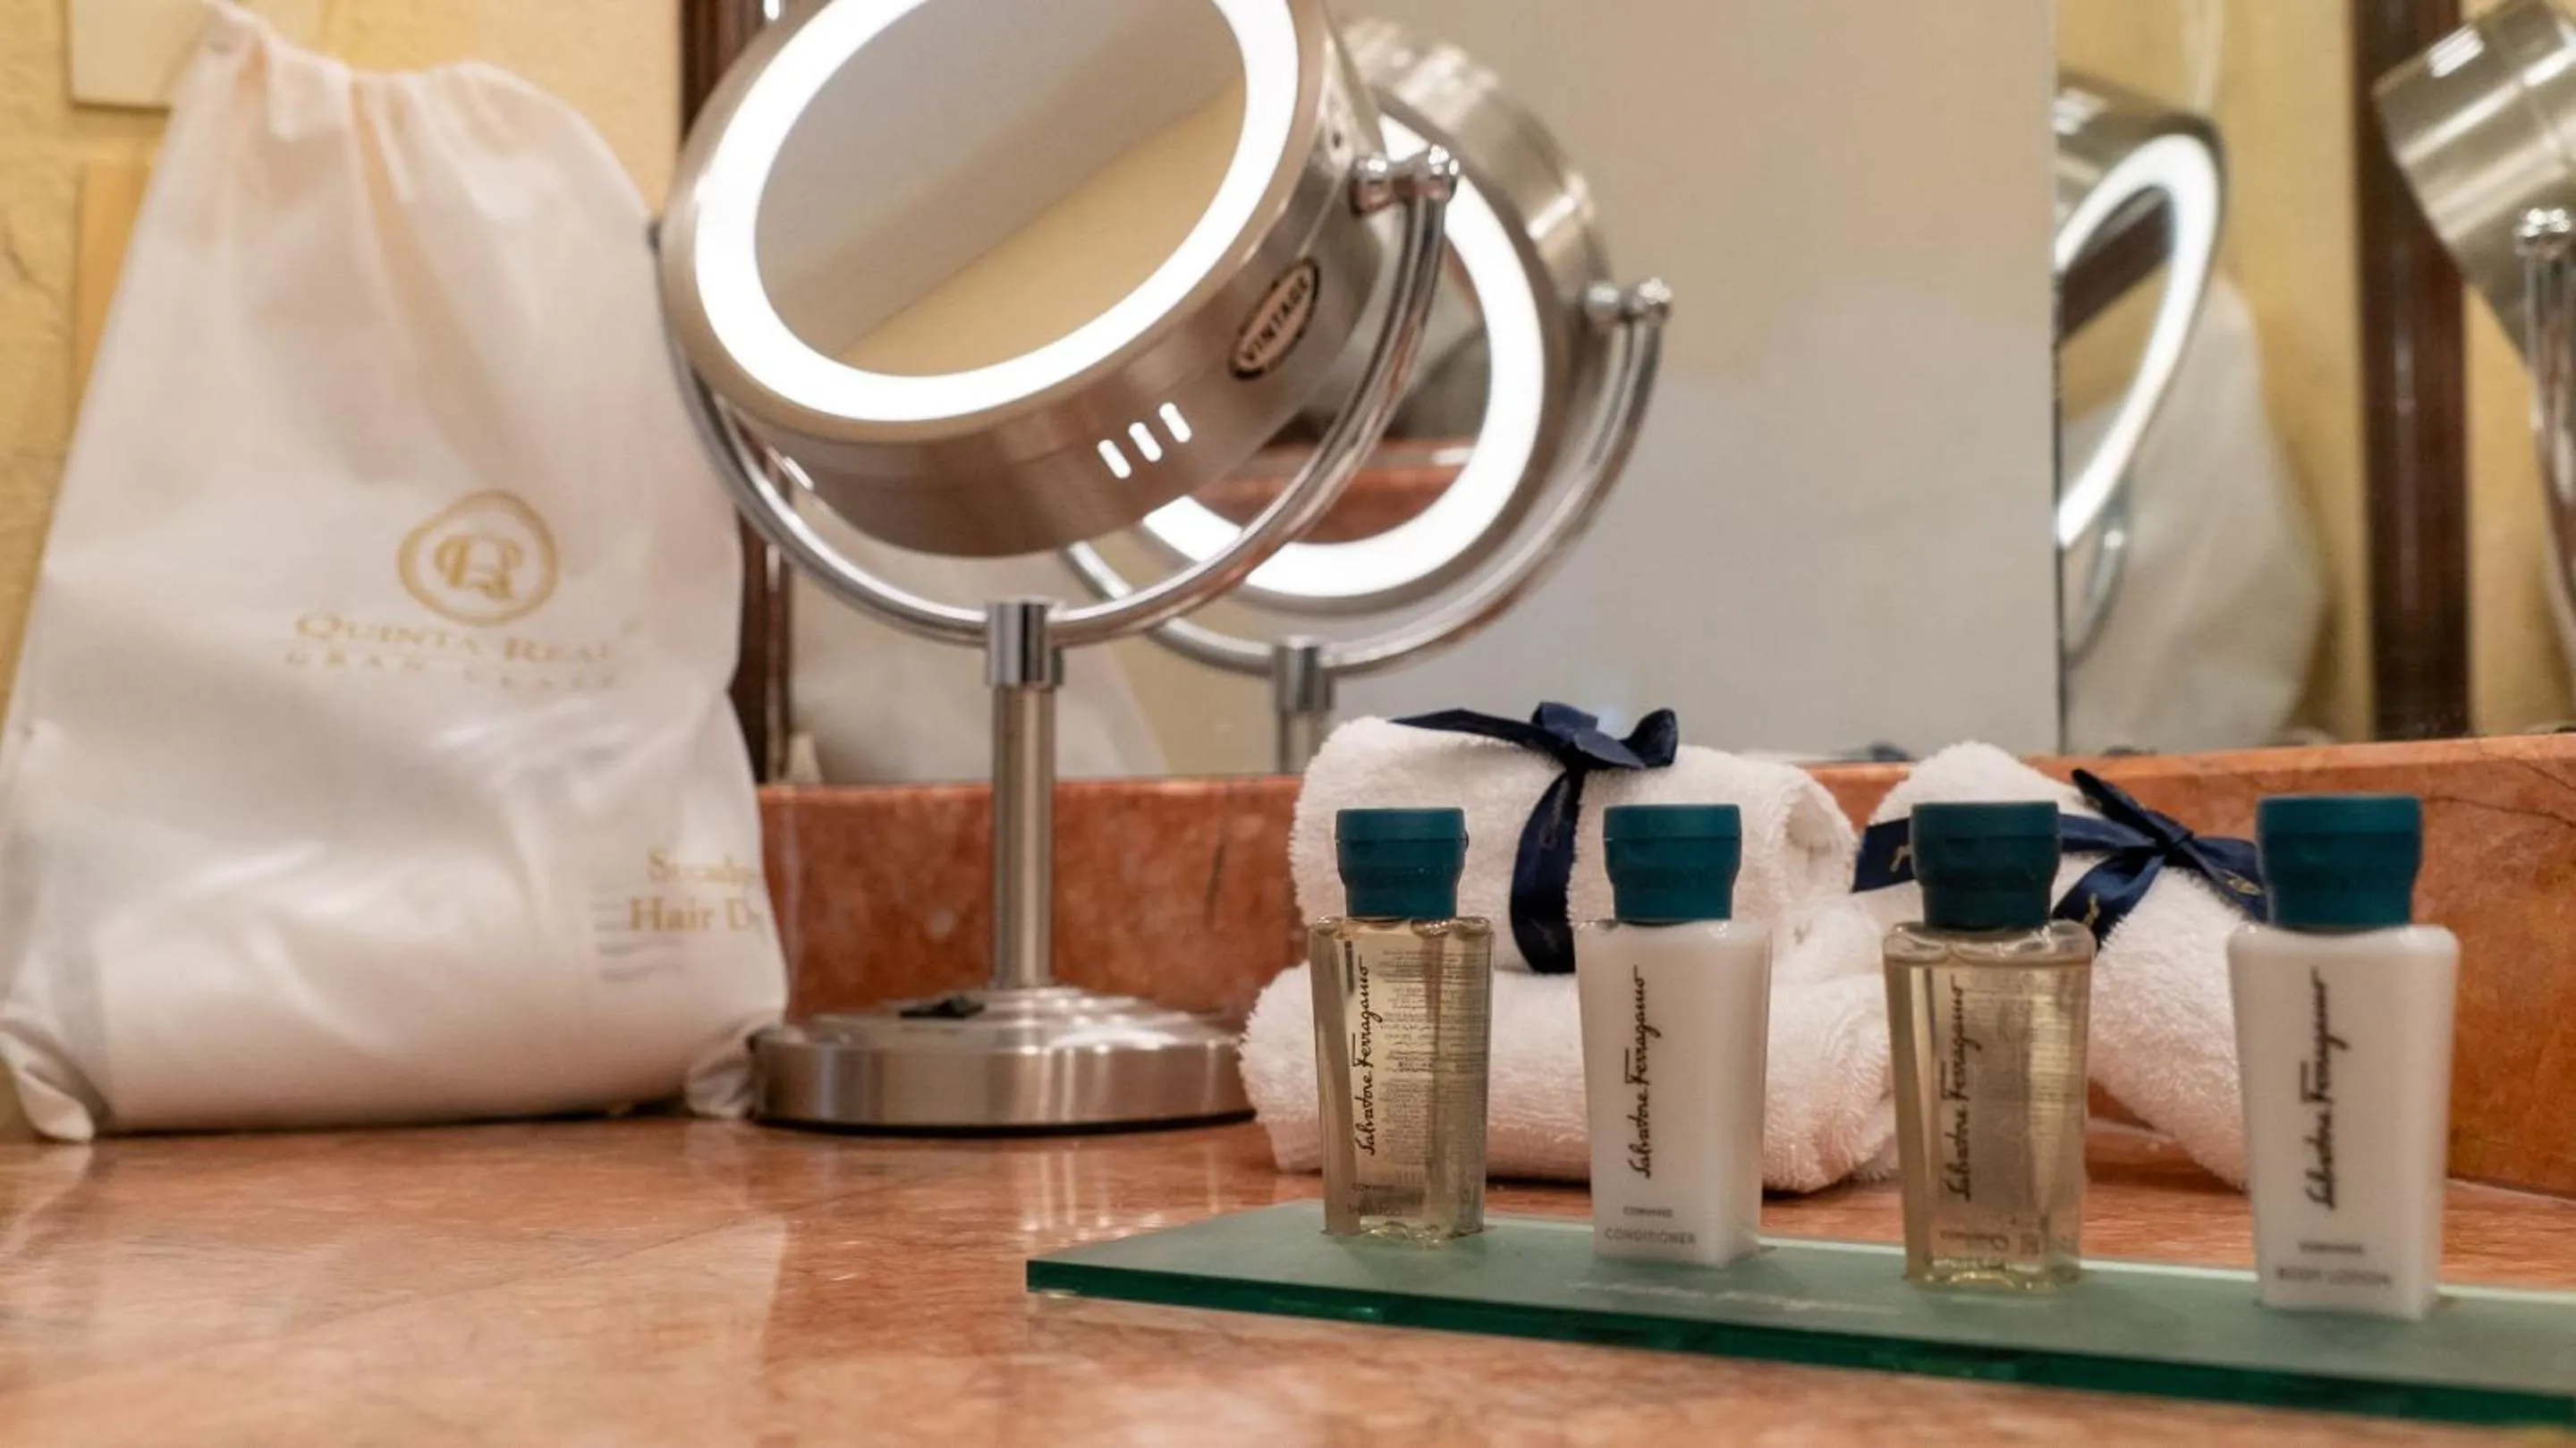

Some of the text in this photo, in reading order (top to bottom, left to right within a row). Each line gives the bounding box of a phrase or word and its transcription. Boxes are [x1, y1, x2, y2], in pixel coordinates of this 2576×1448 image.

[1241, 274, 1309, 362] VINTAGE
[629, 895, 714, 933] Hair
[1351, 954, 1384, 1068] Ferragamo
[1623, 964, 1663, 1086] Ferragamo
[1353, 1071, 1377, 1156] Salvatore
[1625, 1093, 1652, 1180] Salvatore
